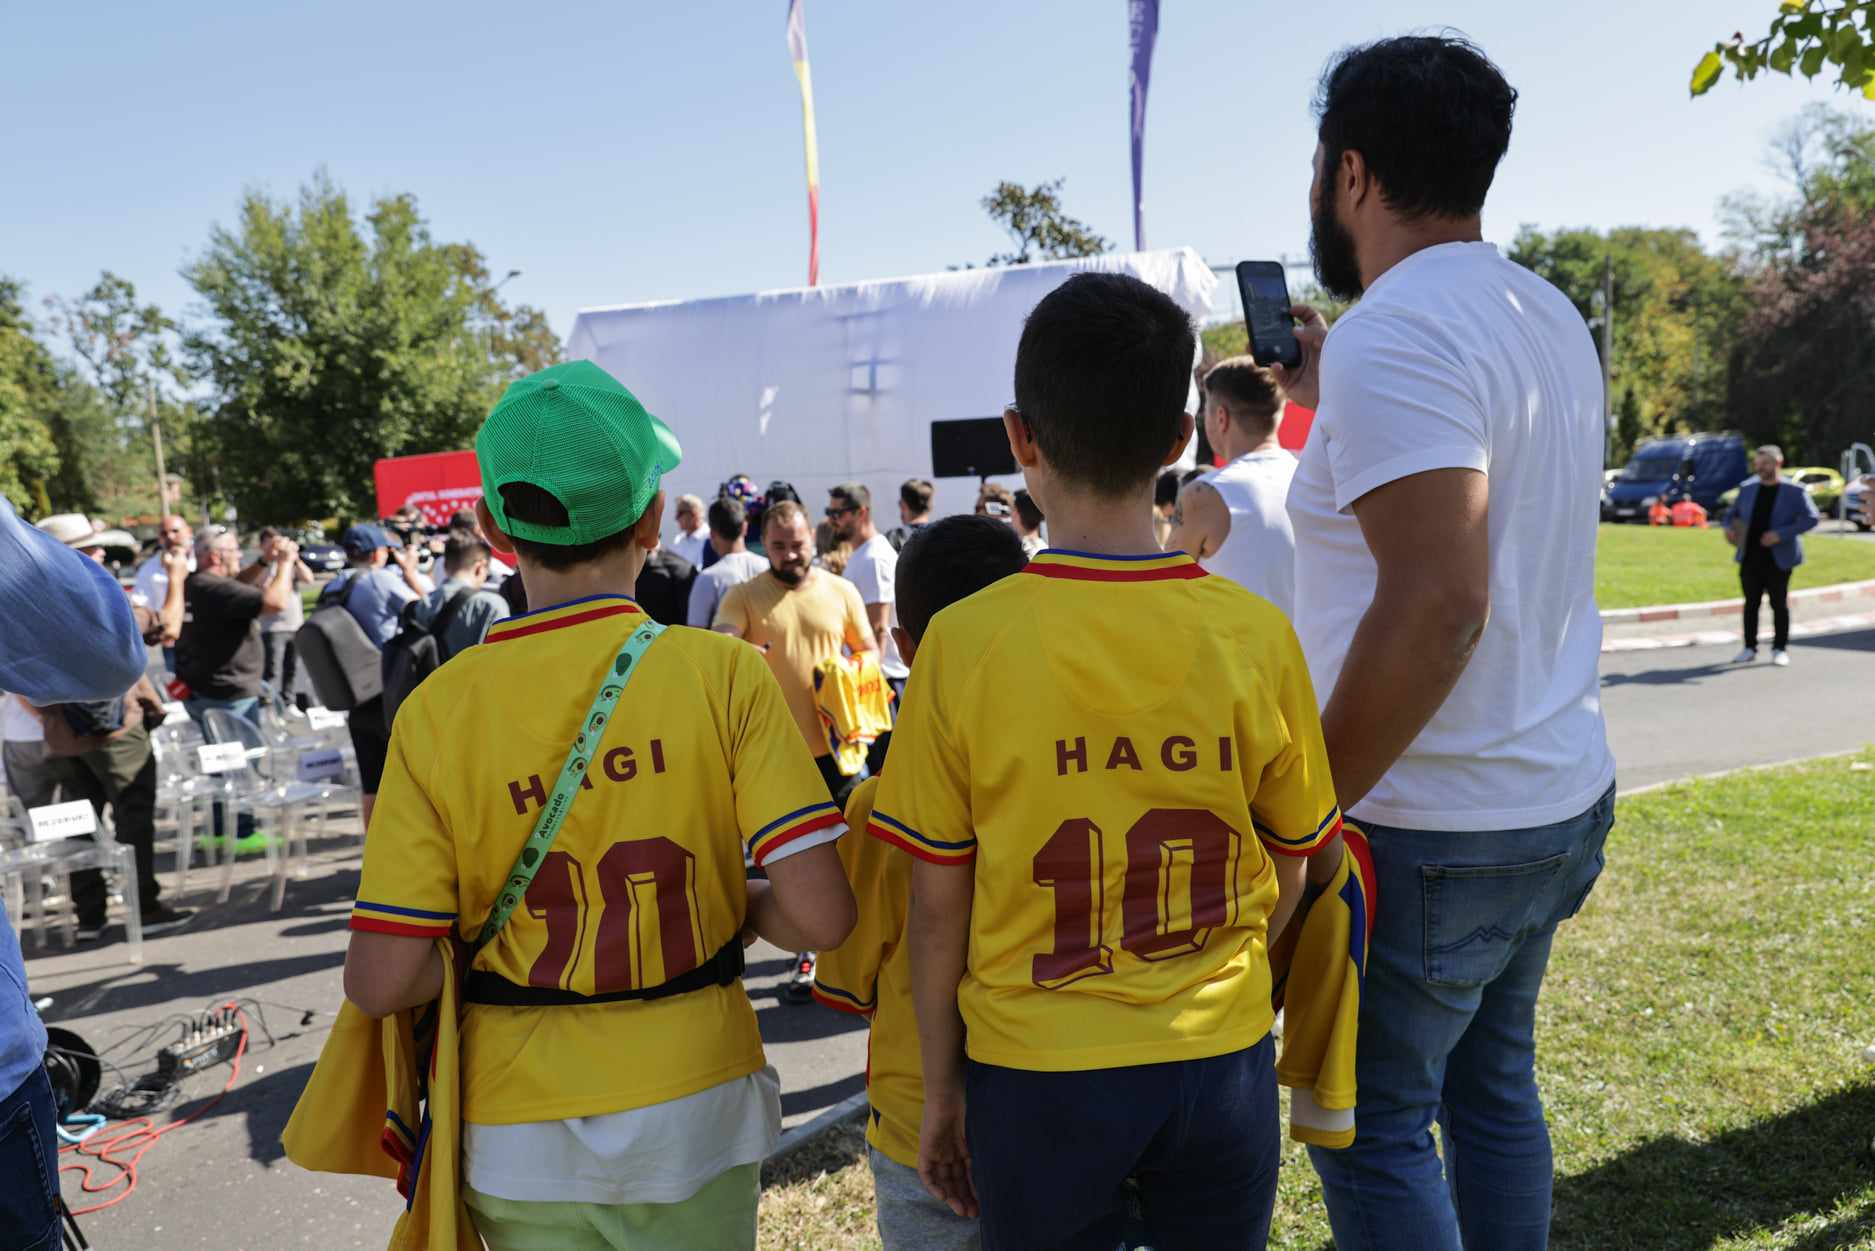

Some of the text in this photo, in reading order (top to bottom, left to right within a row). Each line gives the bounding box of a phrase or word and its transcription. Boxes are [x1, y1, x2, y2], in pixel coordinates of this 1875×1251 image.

[507, 738, 667, 816] HGI
[1055, 735, 1233, 776] HAGI
[538, 792, 566, 839] Avocado
[523, 836, 707, 996] 10
[1031, 807, 1242, 991] 10
